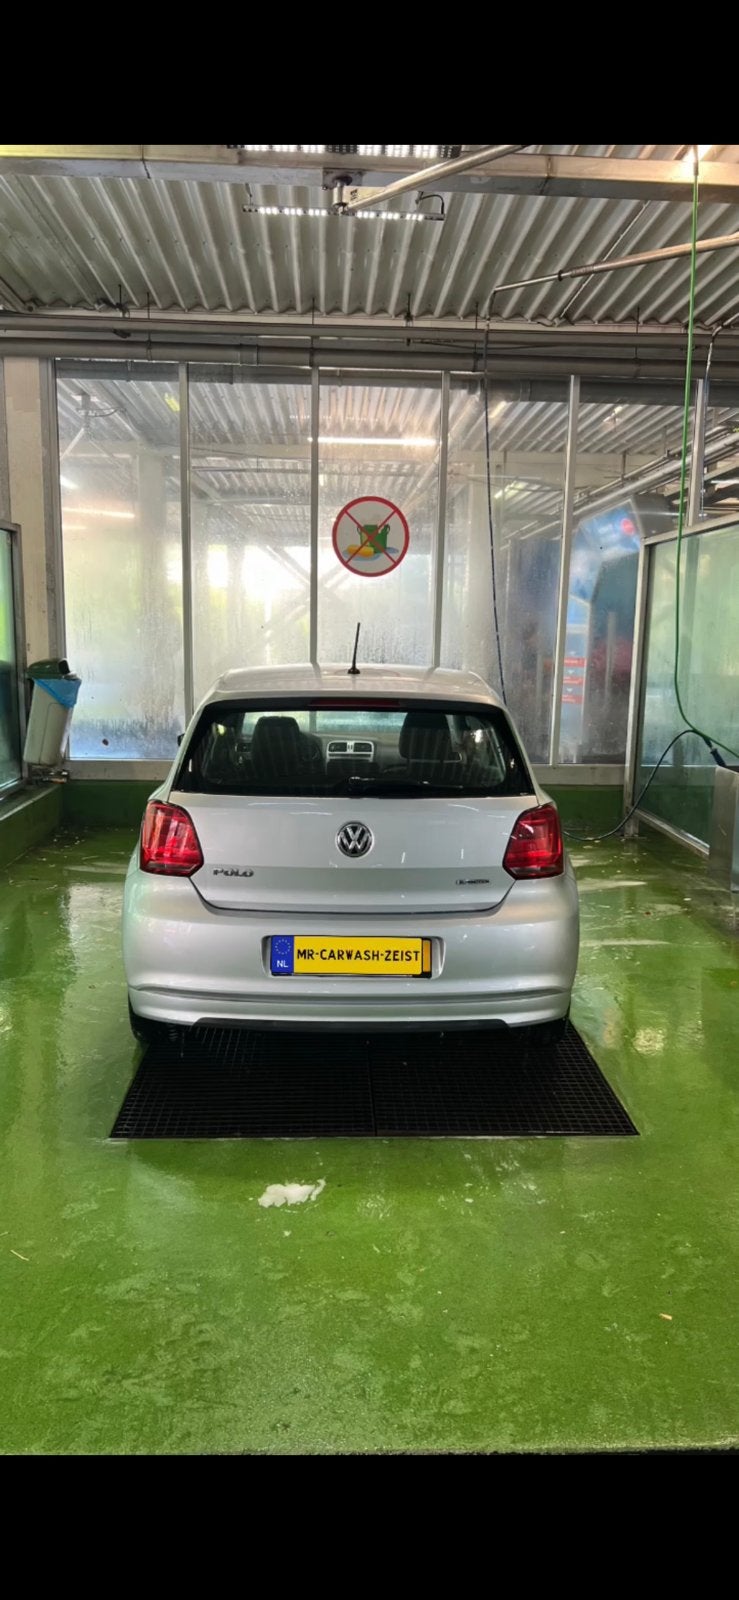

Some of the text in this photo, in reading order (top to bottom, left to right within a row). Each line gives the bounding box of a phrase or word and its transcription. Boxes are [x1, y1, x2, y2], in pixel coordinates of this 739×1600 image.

[338, 824, 371, 852] VW
[213, 868, 254, 878] POLO
[296, 948, 420, 962] MR-CARWASH-ZEIST
[276, 960, 288, 968] NL
